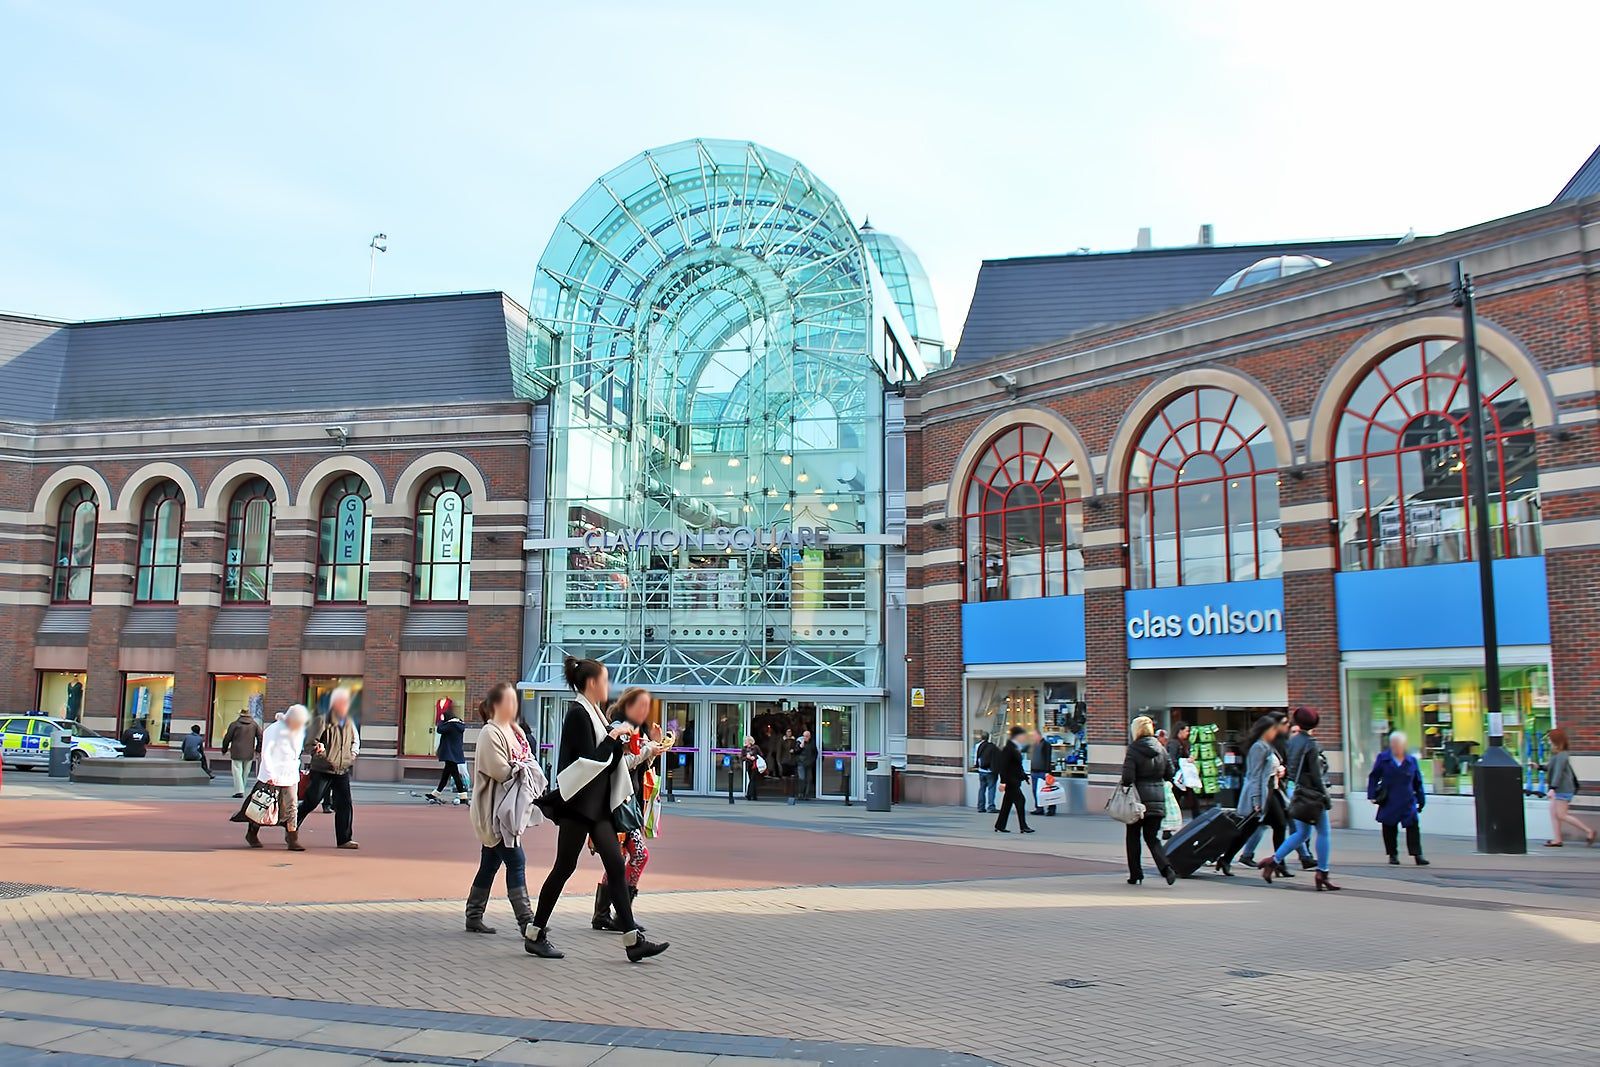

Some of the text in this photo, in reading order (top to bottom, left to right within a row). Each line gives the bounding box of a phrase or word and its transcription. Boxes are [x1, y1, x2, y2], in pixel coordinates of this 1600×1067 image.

[344, 499, 357, 558] GAME
[441, 498, 455, 558] GAME
[582, 526, 830, 552] CLAYTON SQUARE
[1127, 604, 1283, 639] clas ohlson
